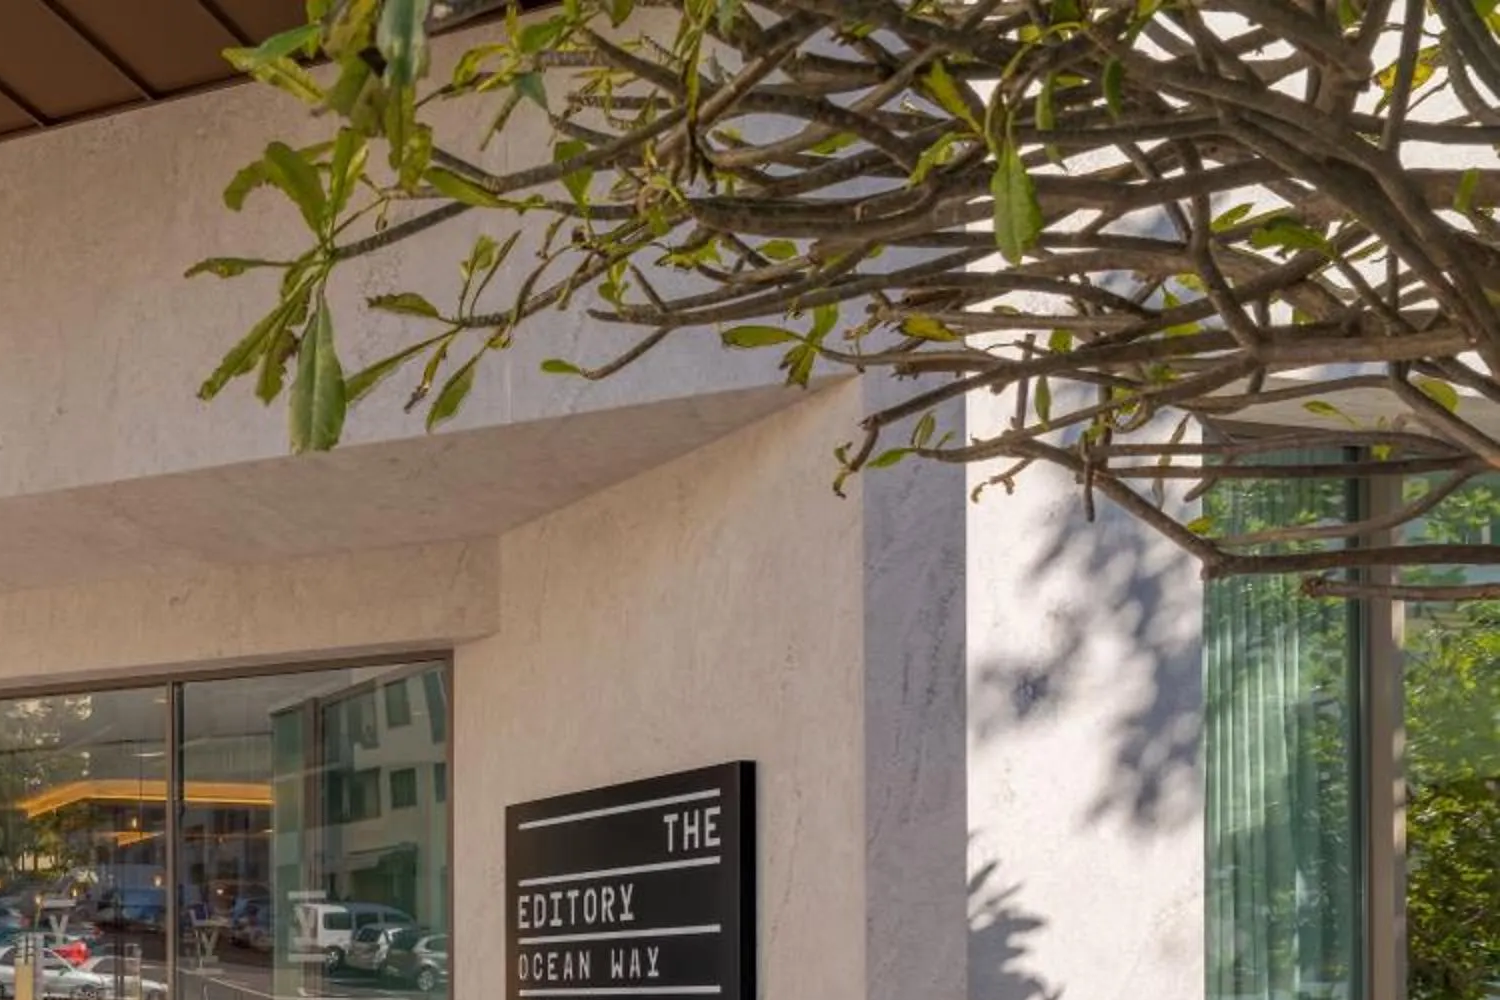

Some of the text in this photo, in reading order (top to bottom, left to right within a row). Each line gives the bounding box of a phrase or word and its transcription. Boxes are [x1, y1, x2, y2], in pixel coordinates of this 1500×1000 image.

[663, 806, 721, 852] THE
[518, 883, 634, 929] EDITORY
[518, 946, 659, 980] OCEAN WAY
